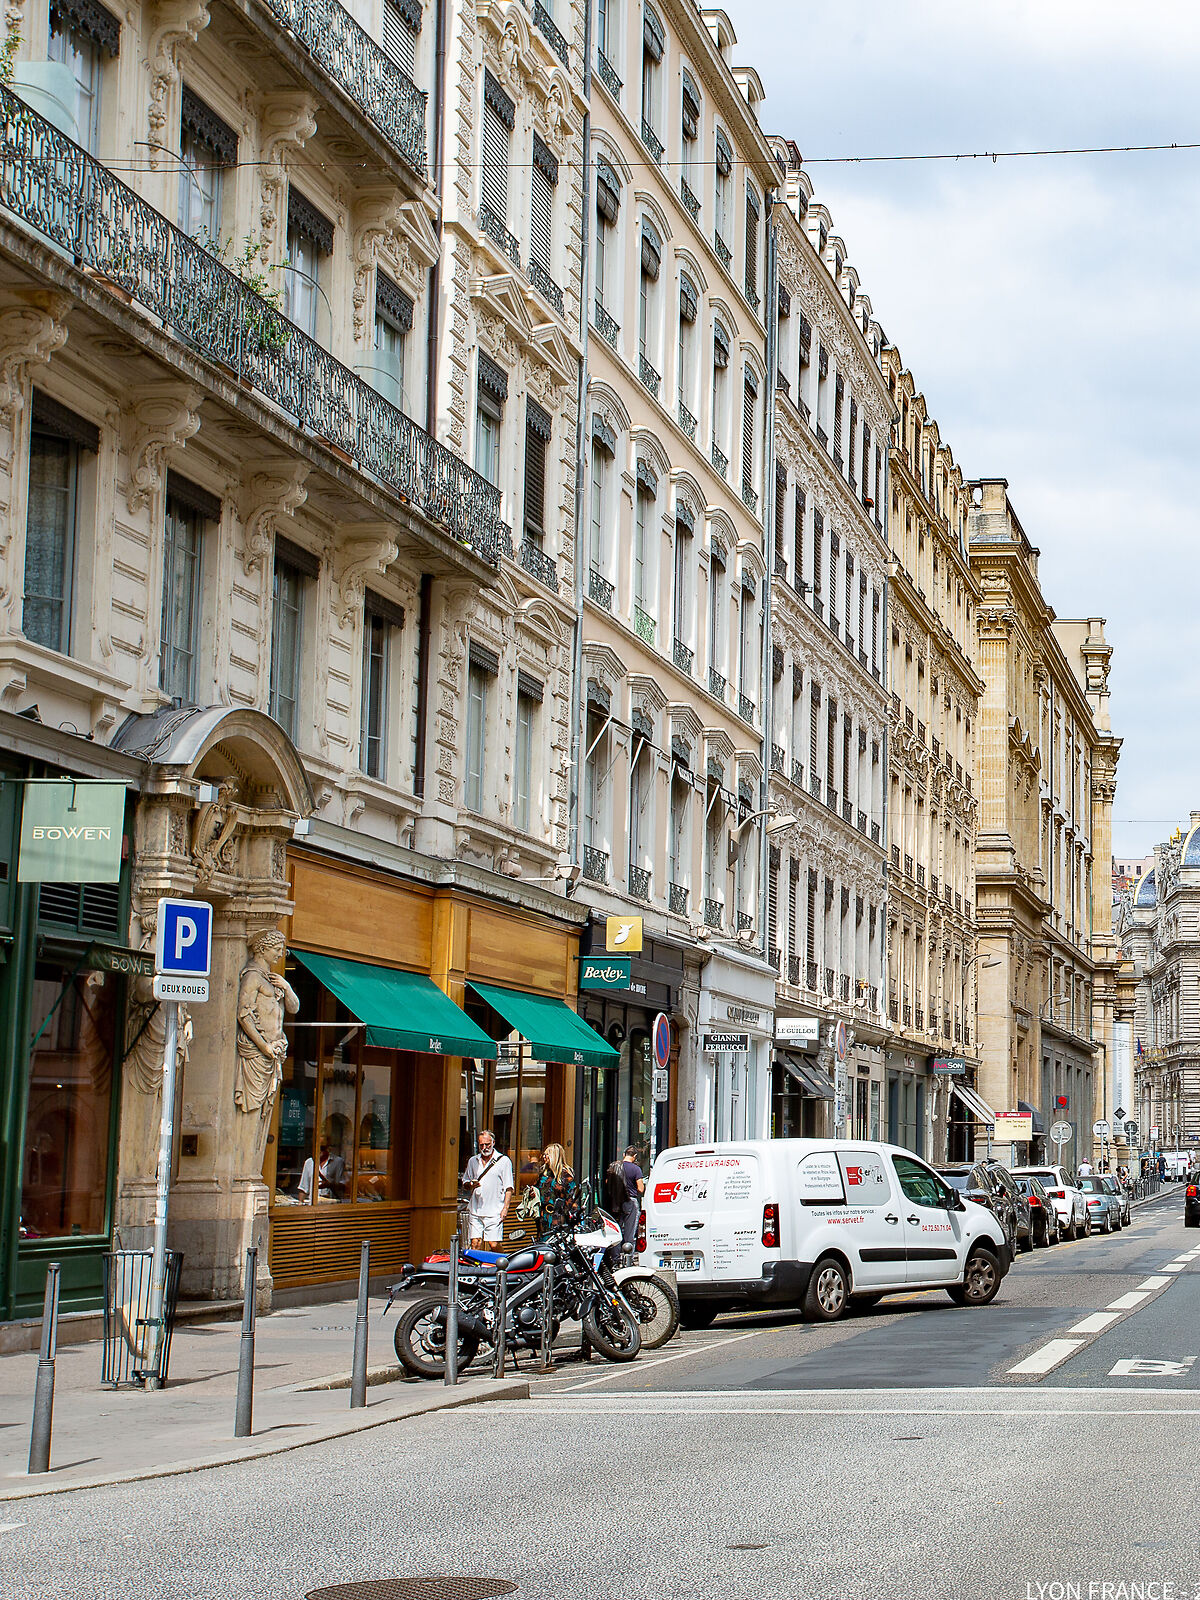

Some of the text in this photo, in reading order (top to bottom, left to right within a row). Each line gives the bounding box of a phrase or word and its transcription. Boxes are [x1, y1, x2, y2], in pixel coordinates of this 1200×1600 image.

[32, 826, 112, 841] BOWEN
[174, 915, 198, 960] P
[111, 954, 152, 977] BOWE
[583, 966, 627, 983] Bexley
[161, 983, 206, 996] DEUX ROUES
[710, 1034, 741, 1042] GIANNI
[677, 1159, 741, 1170] SERVICE LIVRAISON
[827, 1215, 865, 1225] www.servet.fr
